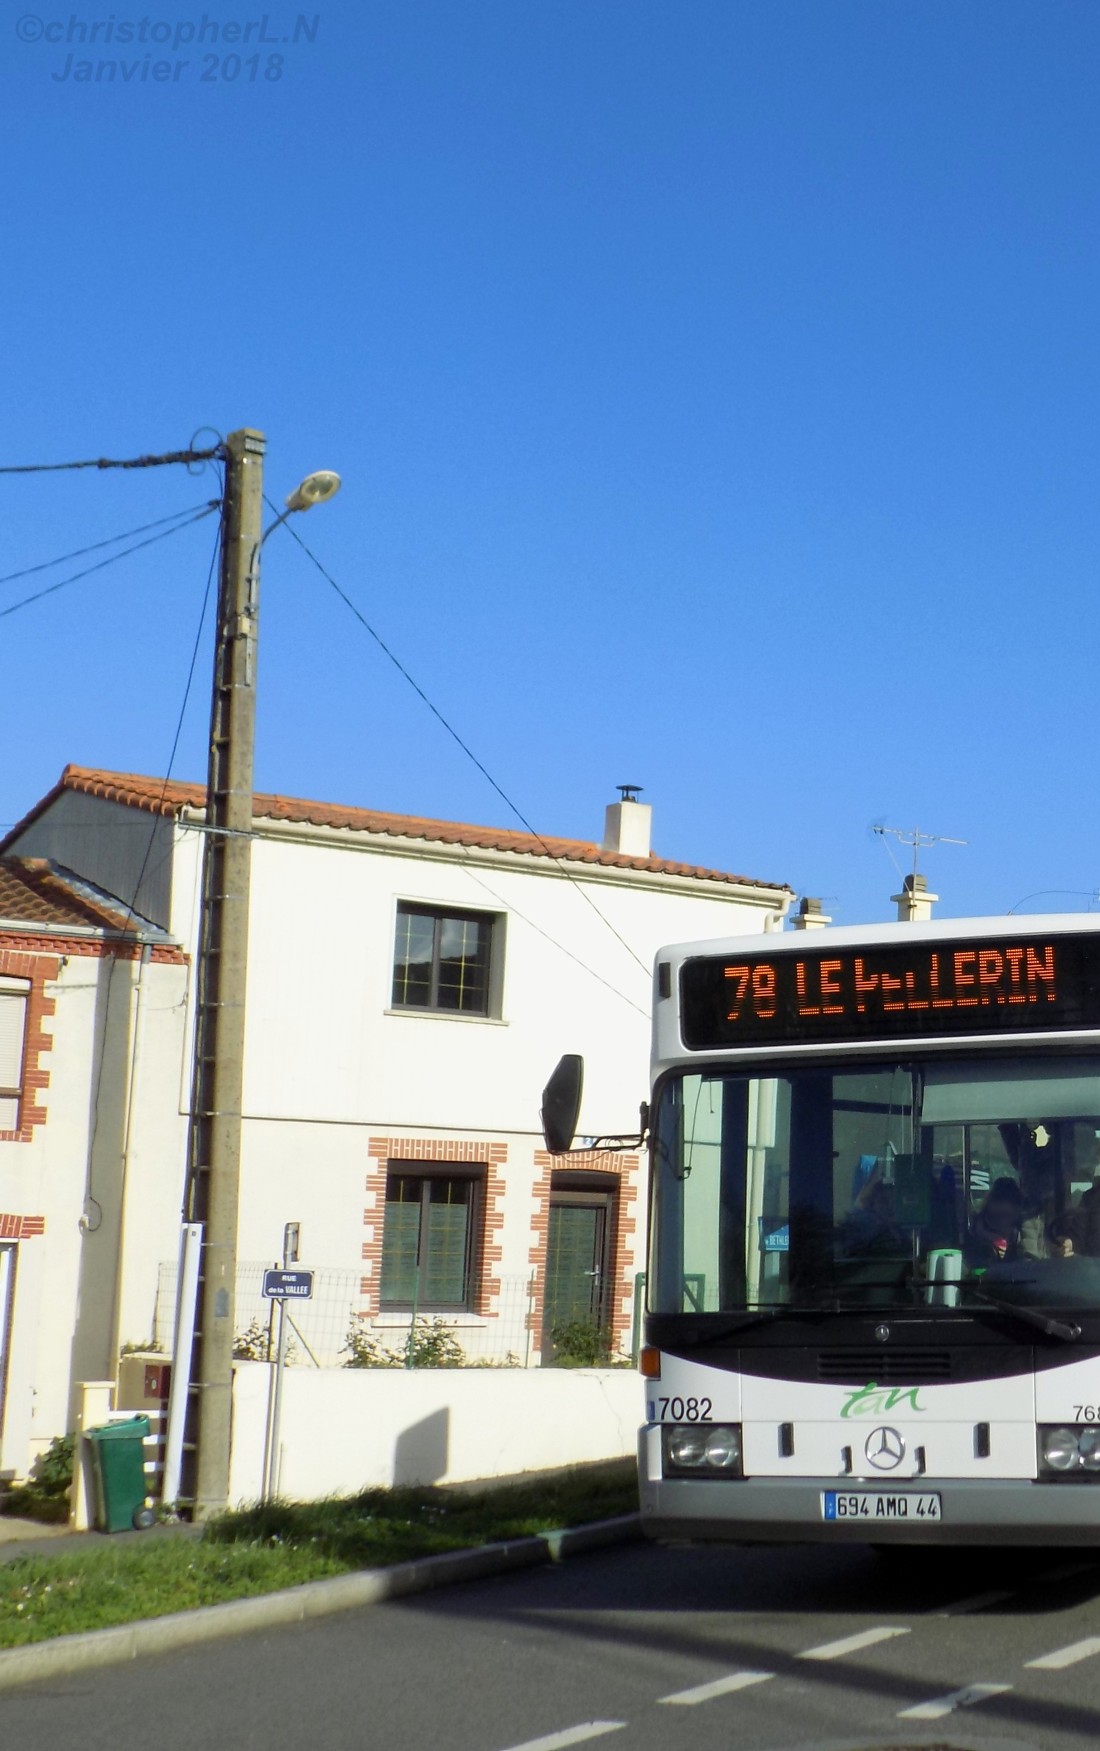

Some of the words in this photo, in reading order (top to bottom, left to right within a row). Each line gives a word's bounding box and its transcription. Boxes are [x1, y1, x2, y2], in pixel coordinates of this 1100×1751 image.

[797, 960, 844, 1014] LE
[658, 1397, 713, 1421] 7082
[840, 1382, 927, 1418] tan
[837, 1497, 869, 1516] 694
[876, 1497, 908, 1516] AMQ
[916, 1498, 937, 1516] 44
